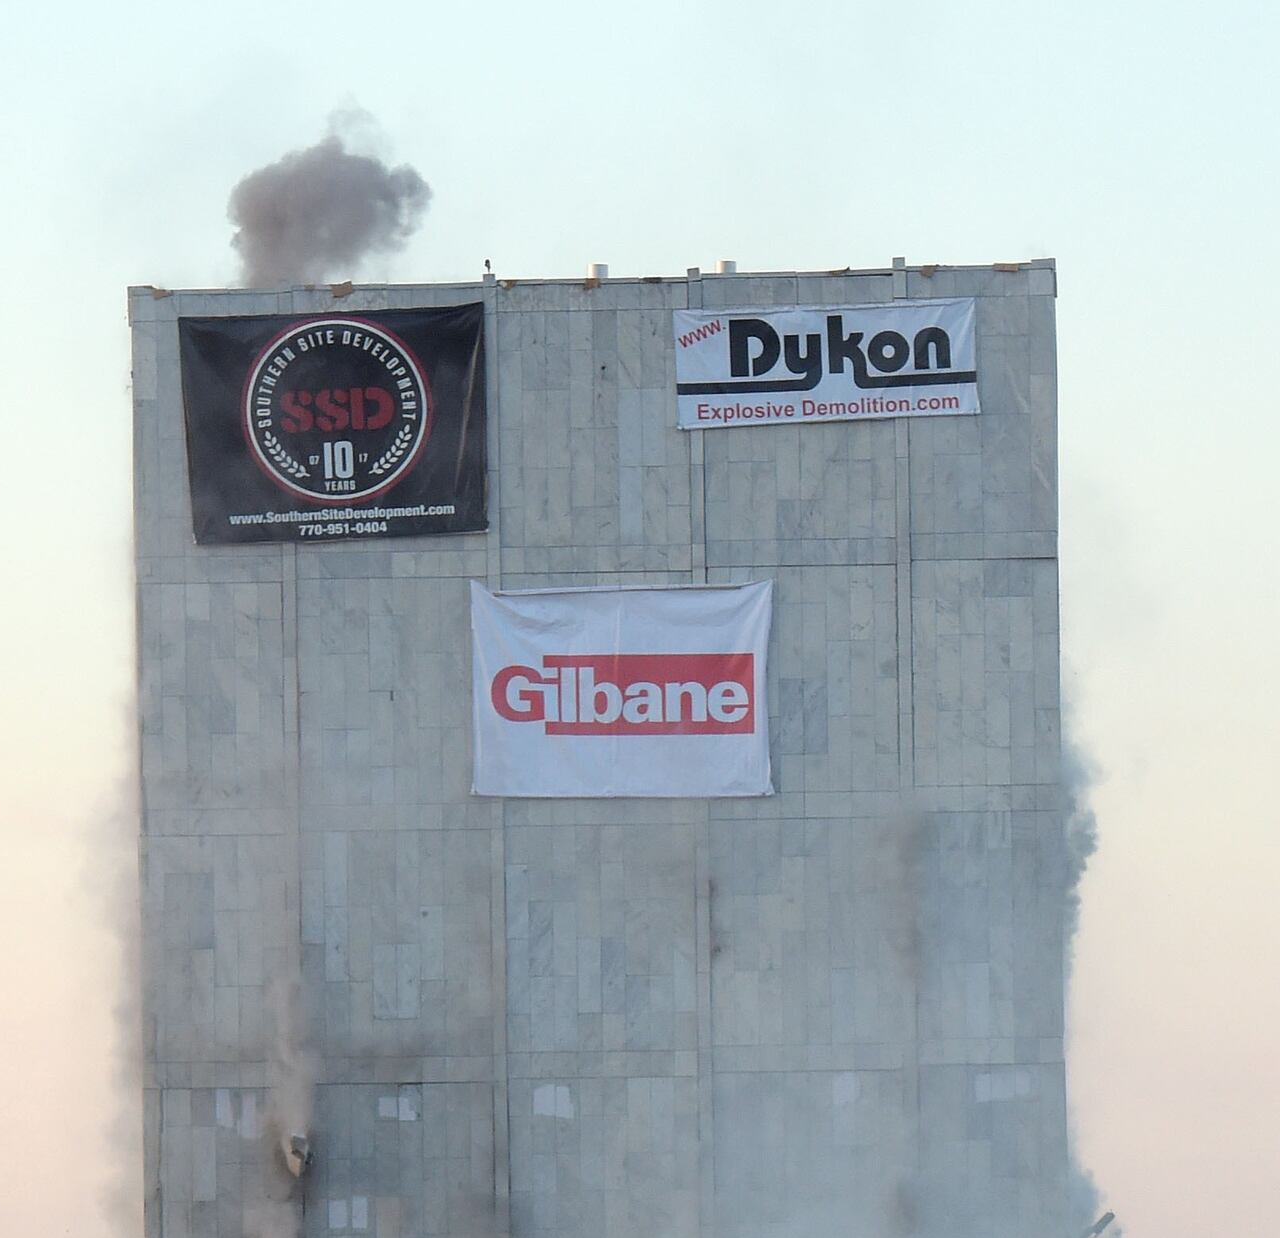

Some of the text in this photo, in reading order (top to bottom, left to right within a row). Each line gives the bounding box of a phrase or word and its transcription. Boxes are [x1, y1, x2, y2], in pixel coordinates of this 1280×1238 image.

[729, 315, 952, 390] Dykon
[256, 330, 417, 428] SOUTHERN SITE DEVELOPMENT
[279, 386, 395, 433] SSD
[697, 395, 959, 423] Explosive Demolition.com
[308, 440, 368, 479] 07 10 17
[324, 479, 356, 491] YEARS
[229, 504, 455, 525] www.SouthernSiteDevelopment.com
[298, 521, 387, 536] 770-951-0404
[491, 665, 748, 723] Gilbane
